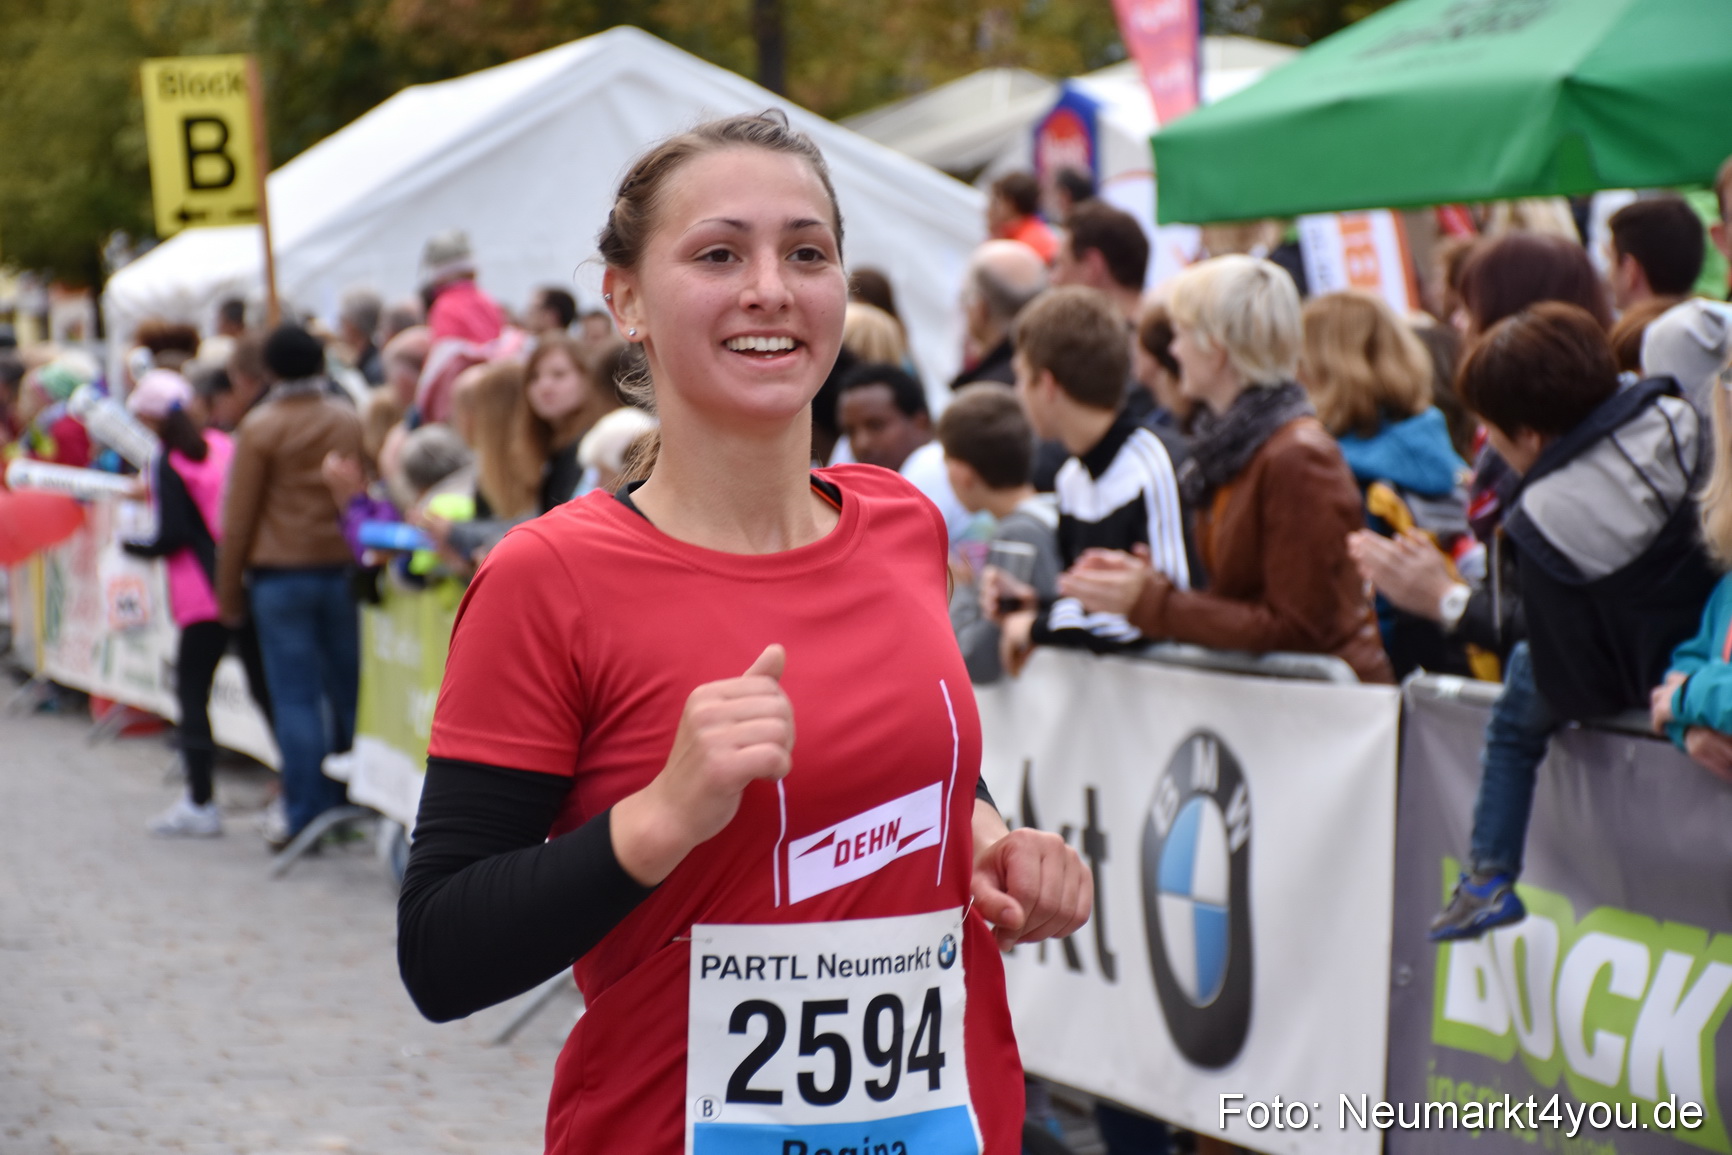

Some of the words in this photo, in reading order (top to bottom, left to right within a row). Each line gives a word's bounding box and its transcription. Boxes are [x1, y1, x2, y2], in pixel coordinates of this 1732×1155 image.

[157, 69, 246, 101] Block
[183, 115, 236, 191] B
[833, 816, 902, 869] DEHN
[700, 955, 808, 981] PARTL
[817, 946, 932, 980] Neumarkt
[725, 986, 946, 1107] 2594
[702, 1099, 714, 1118] B
